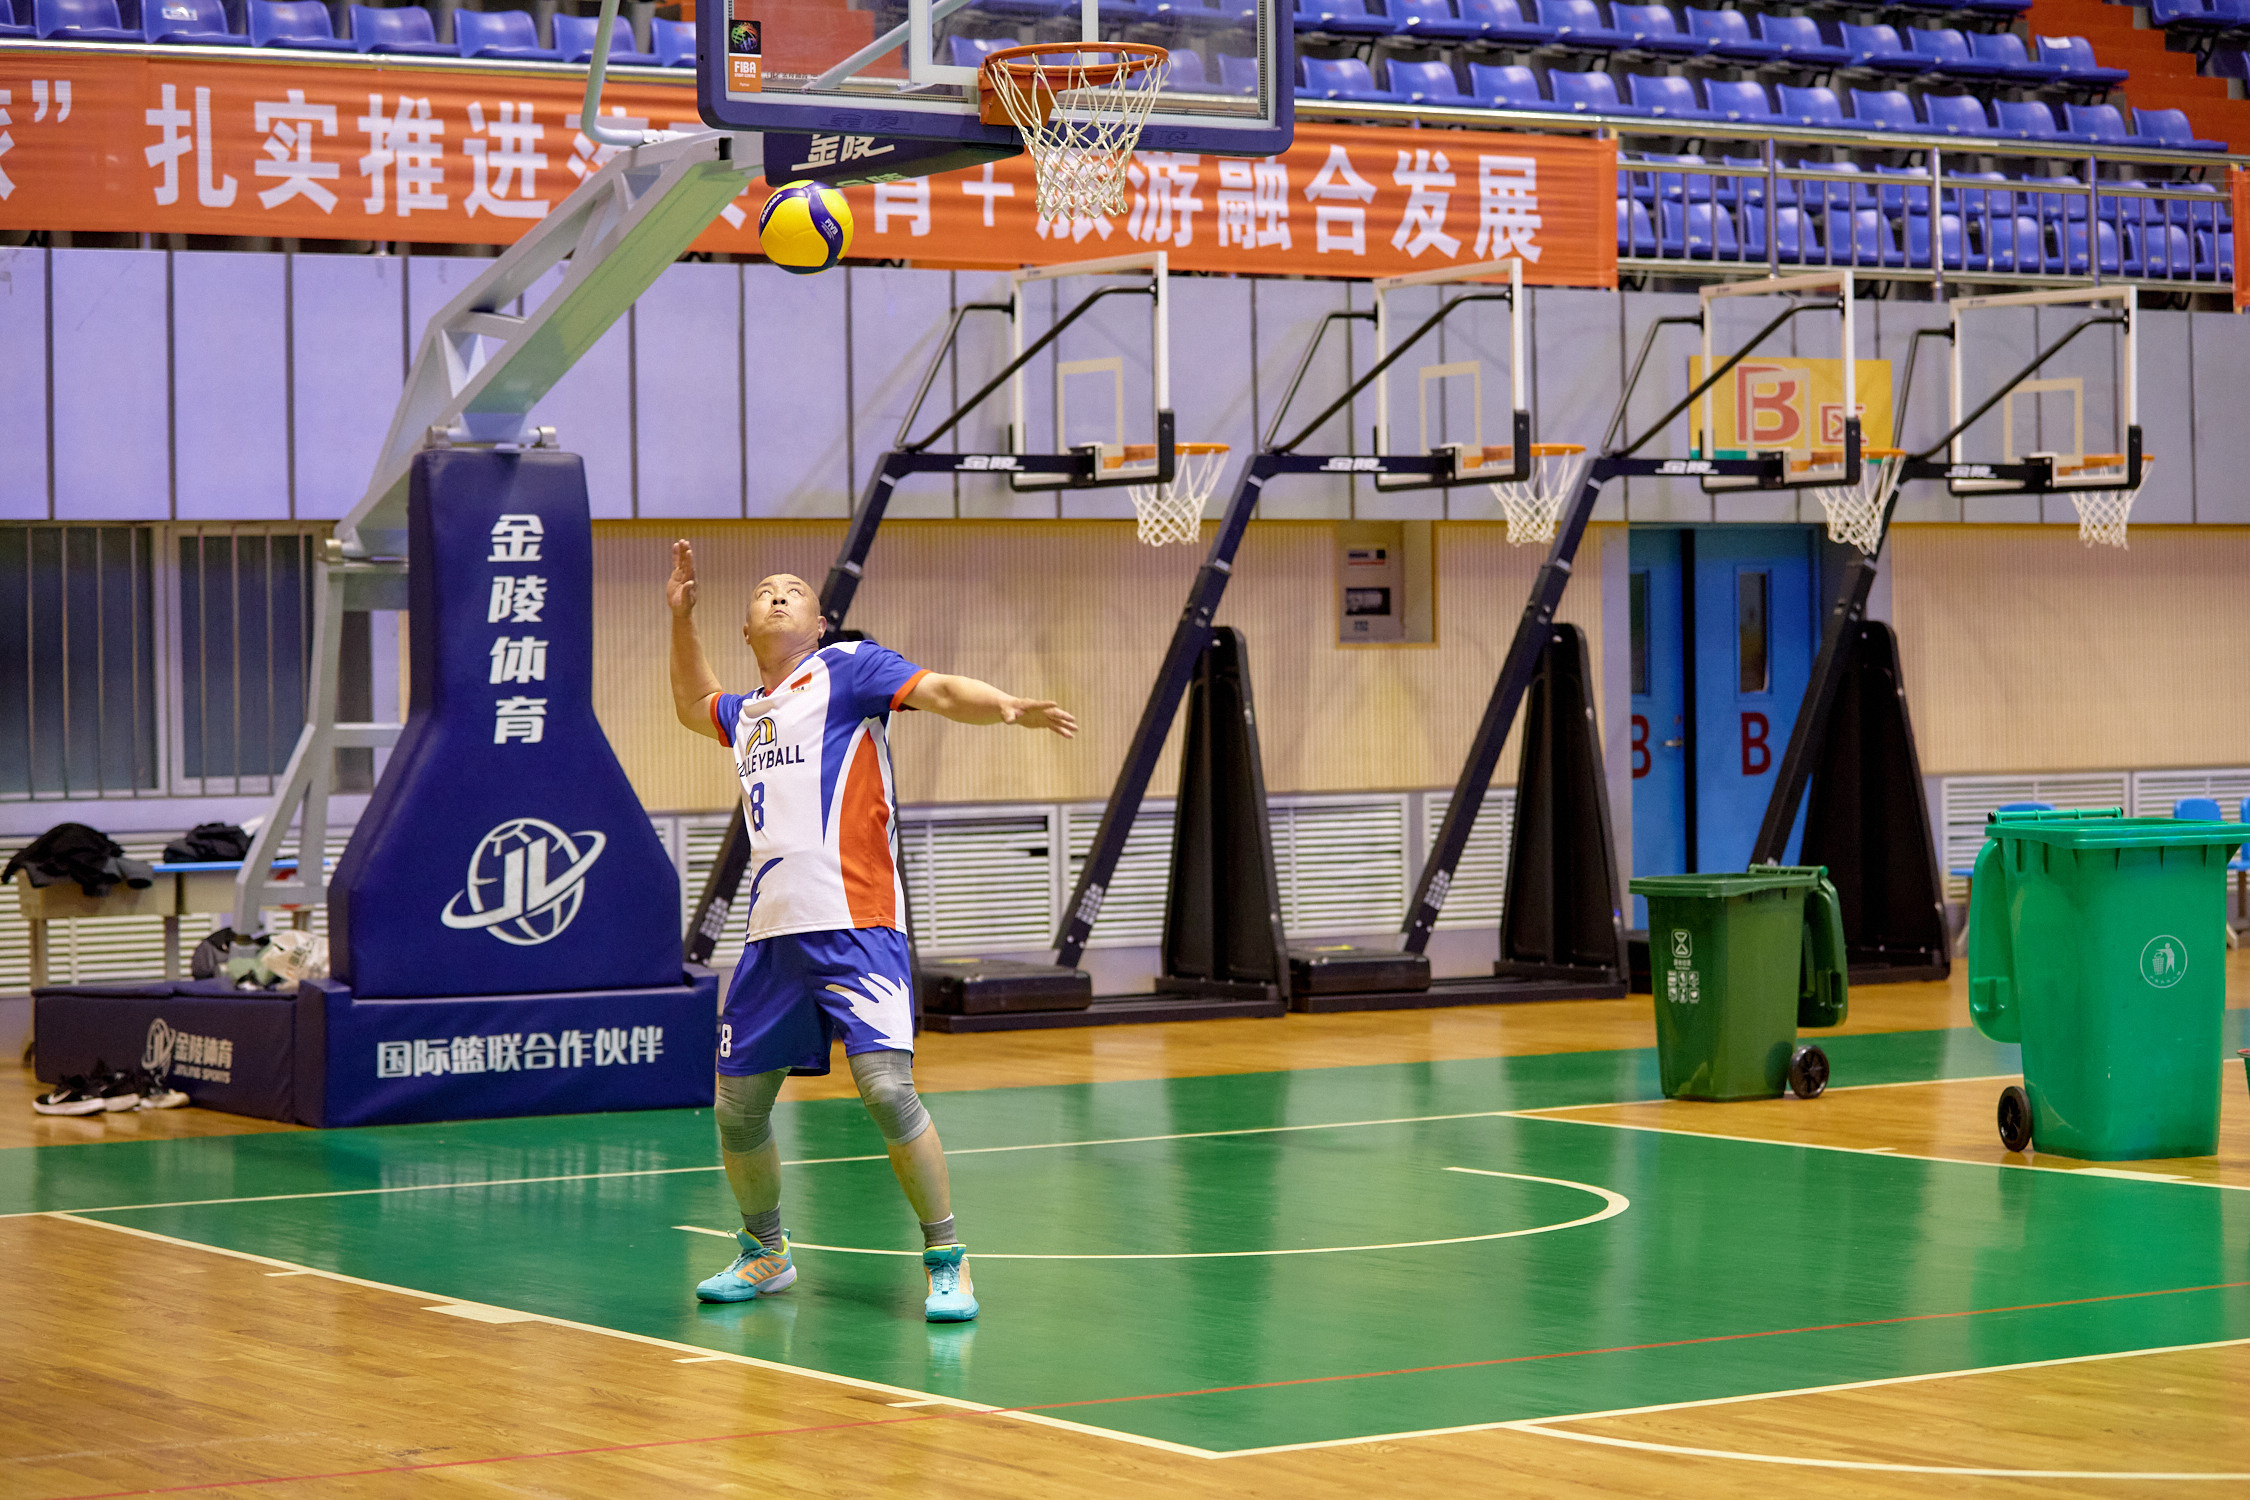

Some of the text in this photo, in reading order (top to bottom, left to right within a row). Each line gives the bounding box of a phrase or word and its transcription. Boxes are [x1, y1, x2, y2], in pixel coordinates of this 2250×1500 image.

[734, 61, 757, 73] FIBA
[487, 514, 549, 744] 金陵体育
[1741, 711, 1772, 777] B
[750, 782, 765, 832] 8
[376, 1025, 664, 1079] 国际篮联合作伙伴
[720, 1023, 733, 1058] 8
